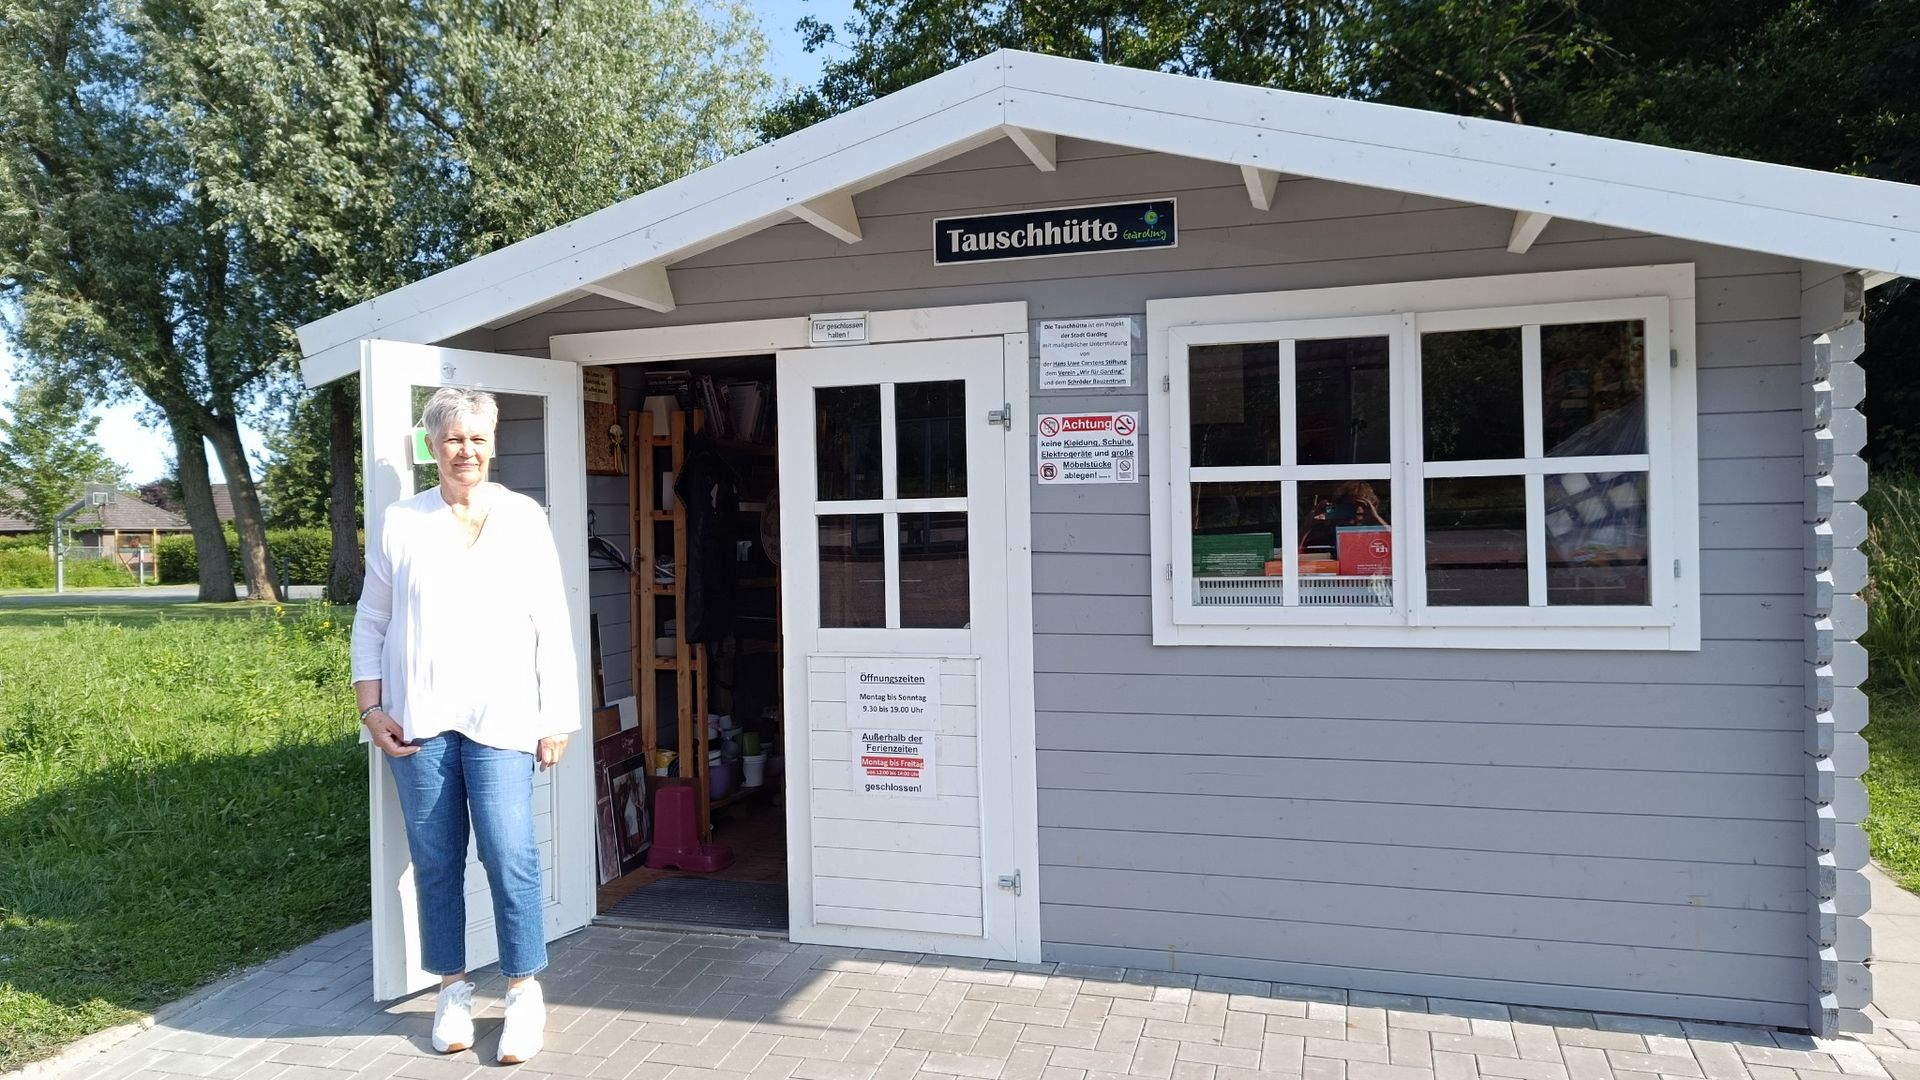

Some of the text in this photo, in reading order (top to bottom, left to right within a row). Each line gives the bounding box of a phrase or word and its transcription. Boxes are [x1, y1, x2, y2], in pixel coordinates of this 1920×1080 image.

[947, 219, 1168, 252] Tauschhütte Garding
[1062, 420, 1112, 430] Achtung
[1041, 451, 1092, 459] Elektrogeräte
[1111, 449, 1134, 457] große
[1063, 461, 1112, 469] Möbelstücke
[1064, 472, 1097, 480] ablegen!
[860, 672, 925, 684] Öffnungszeiten
[898, 694, 927, 702] Sonntag
[862, 733, 922, 743] Außerhalb der
[866, 744, 918, 753] Ferienzeiten
[863, 759, 888, 767] Montag
[890, 759, 899, 767] bis
[865, 783, 921, 792] geschlossen!
